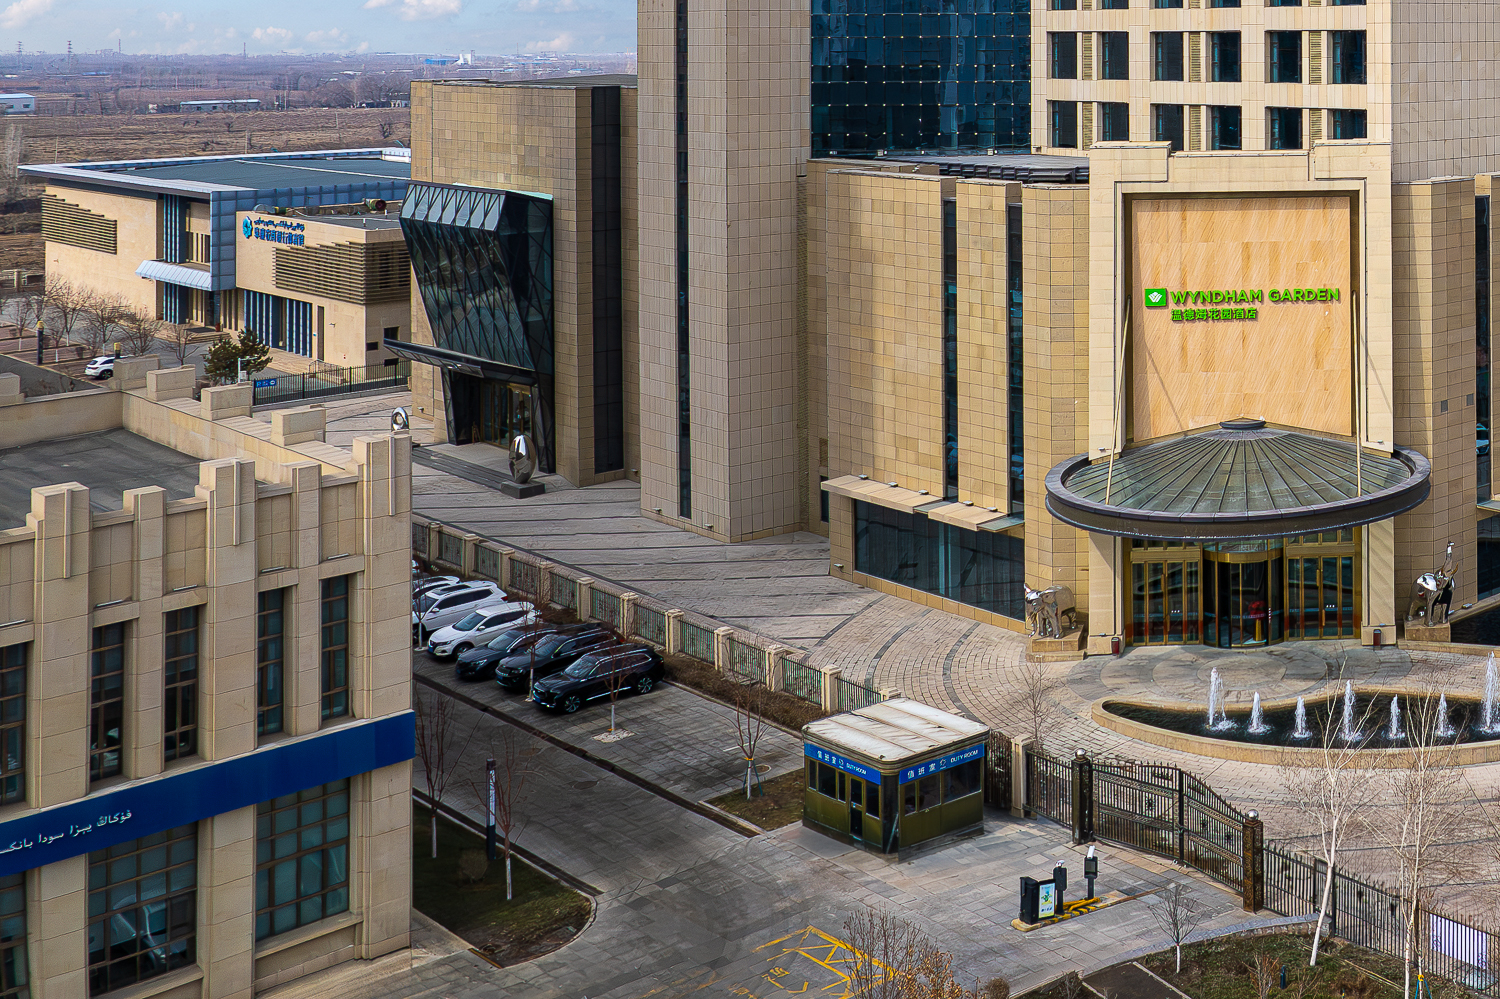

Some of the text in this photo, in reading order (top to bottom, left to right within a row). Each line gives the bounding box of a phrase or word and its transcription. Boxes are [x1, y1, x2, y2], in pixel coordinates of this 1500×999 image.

[1170, 287, 1339, 304] WYNDHAM GARDEN
[1170, 306, 1257, 321] 温德姆花园酒店
[950, 754, 964, 763] DUTY
[964, 749, 979, 759] ROOM
